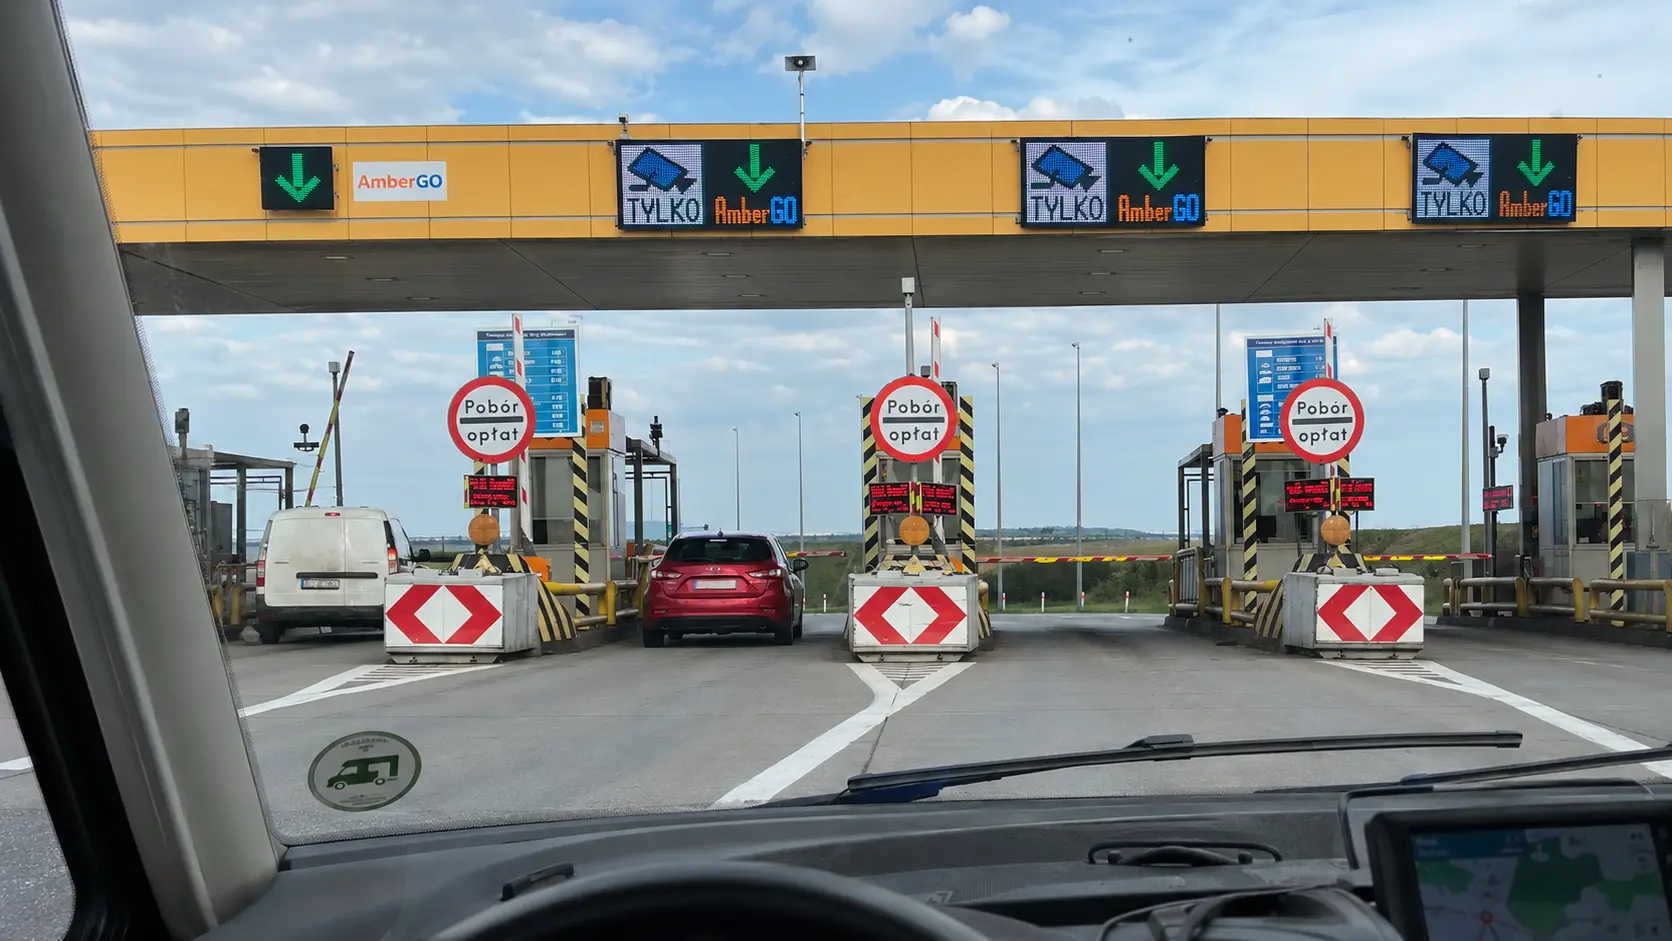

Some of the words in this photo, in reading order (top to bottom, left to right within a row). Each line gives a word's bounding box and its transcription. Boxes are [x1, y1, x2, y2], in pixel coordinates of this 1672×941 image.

[358, 174, 443, 190] AmberGO
[627, 197, 701, 224] TYLKO
[714, 196, 798, 225] AmberGO
[1030, 195, 1104, 221] TYLKO
[1118, 194, 1199, 222] AmberGO
[1420, 191, 1486, 216] TYLKO
[1499, 190, 1572, 217] AmberGO
[465, 399, 519, 414] Pobór
[887, 399, 940, 414] Pobór
[1297, 400, 1348, 414] Pobór
[467, 427, 519, 445] opłat
[889, 426, 939, 444] opłat
[1298, 429, 1348, 445] opłat
